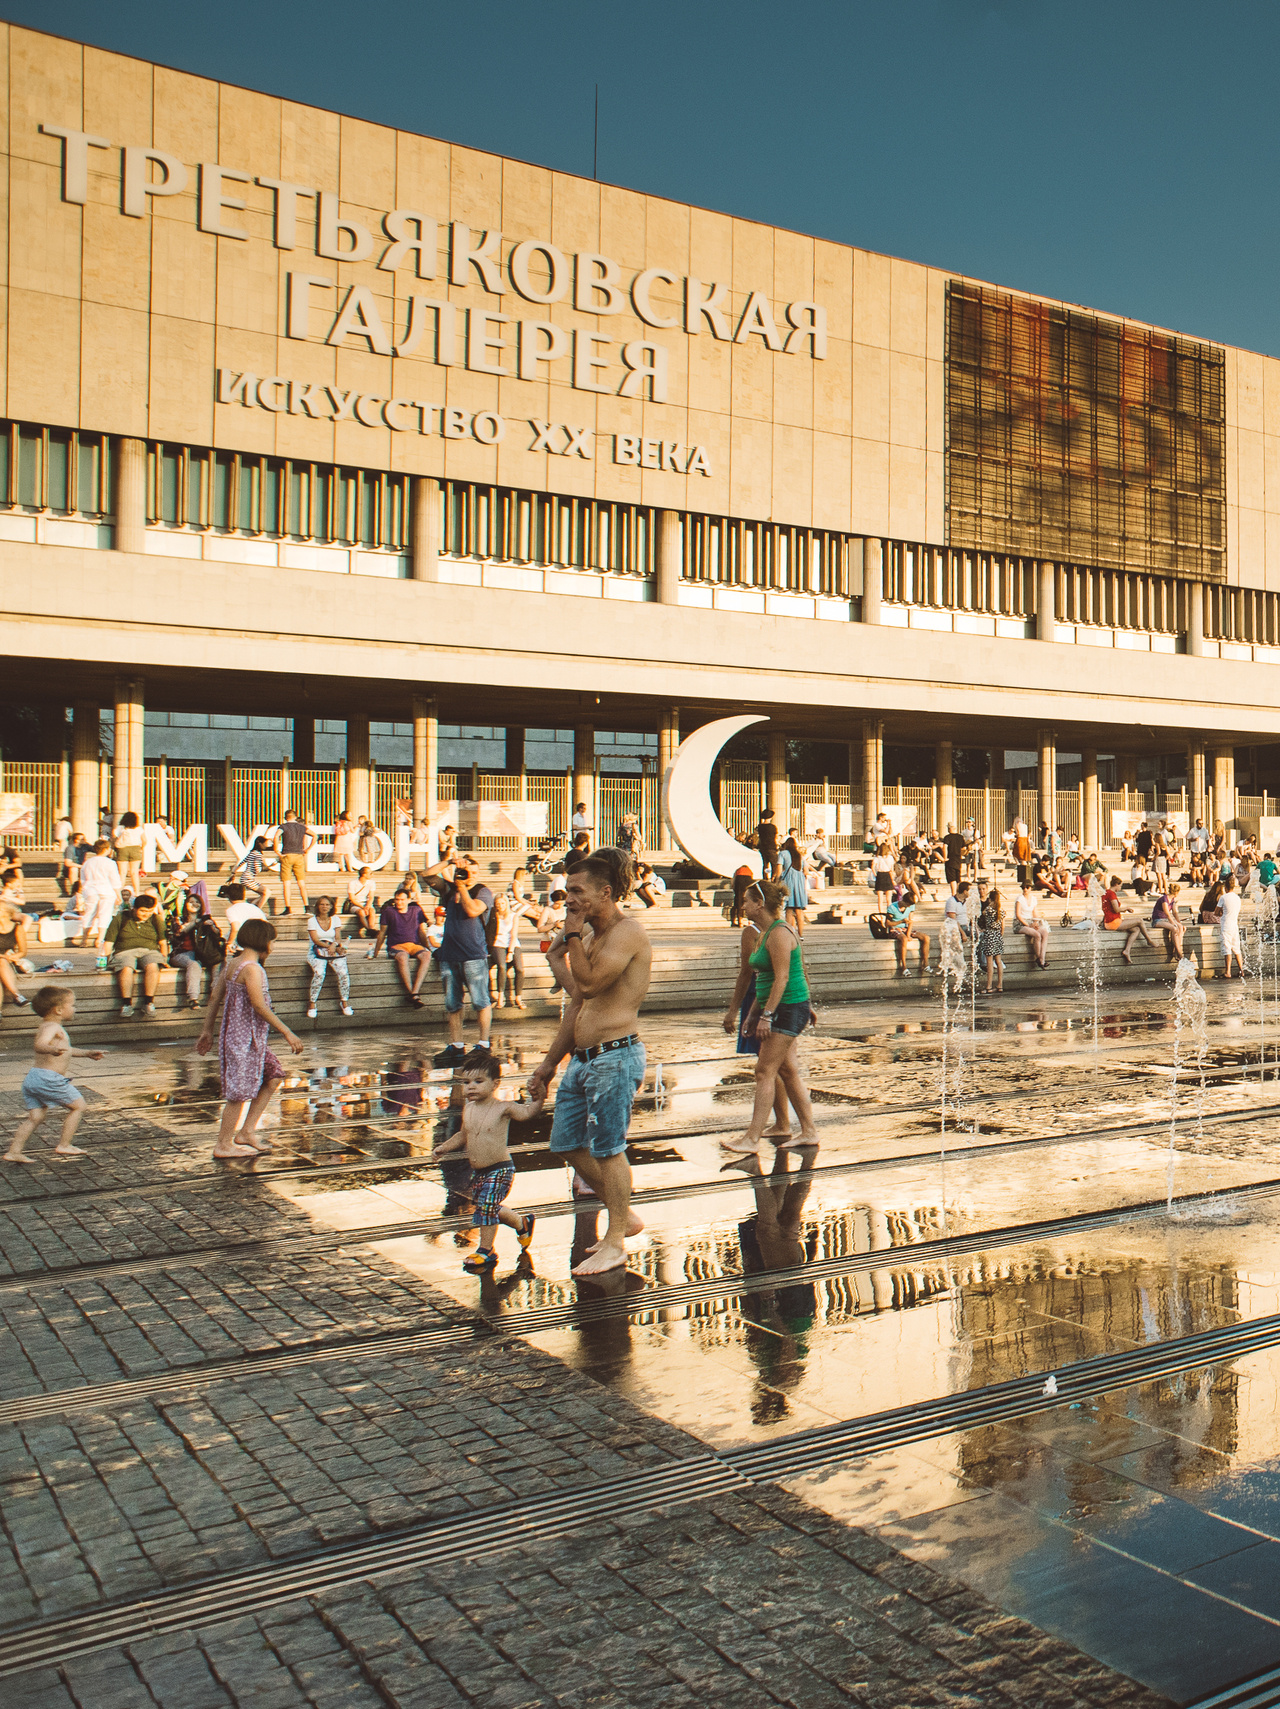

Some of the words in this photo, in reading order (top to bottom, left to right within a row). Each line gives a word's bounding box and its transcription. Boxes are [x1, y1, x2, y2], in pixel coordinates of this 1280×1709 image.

[38, 123, 829, 361] ТРЕТЬЯКОВСКАЯ
[285, 271, 670, 404] ГАЛЕРЕЯ
[216, 367, 506, 446] ИСКУССТВО
[613, 433, 715, 478] ВЕКА
